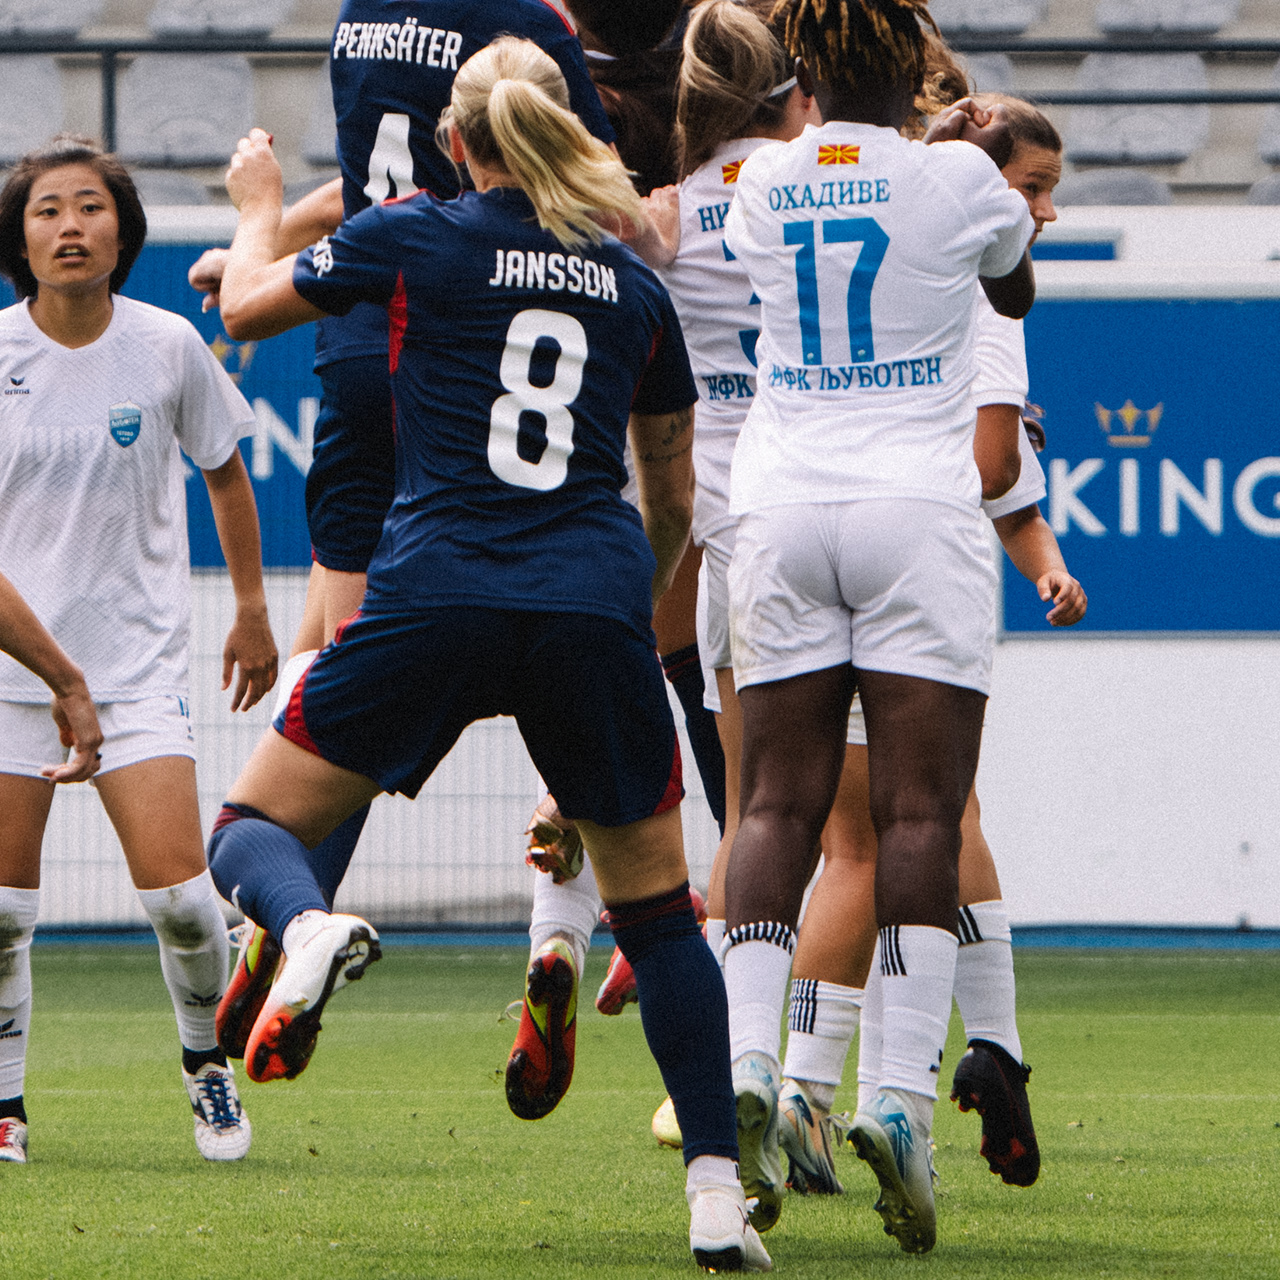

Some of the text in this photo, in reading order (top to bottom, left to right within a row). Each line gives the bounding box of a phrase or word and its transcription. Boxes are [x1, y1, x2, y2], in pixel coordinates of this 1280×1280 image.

[333, 17, 463, 70] PENNSÄTER
[769, 178, 891, 211] ОХАДИВЕ
[489, 249, 619, 304] JANSSON
[783, 216, 891, 366] 17
[487, 308, 589, 491] 8
